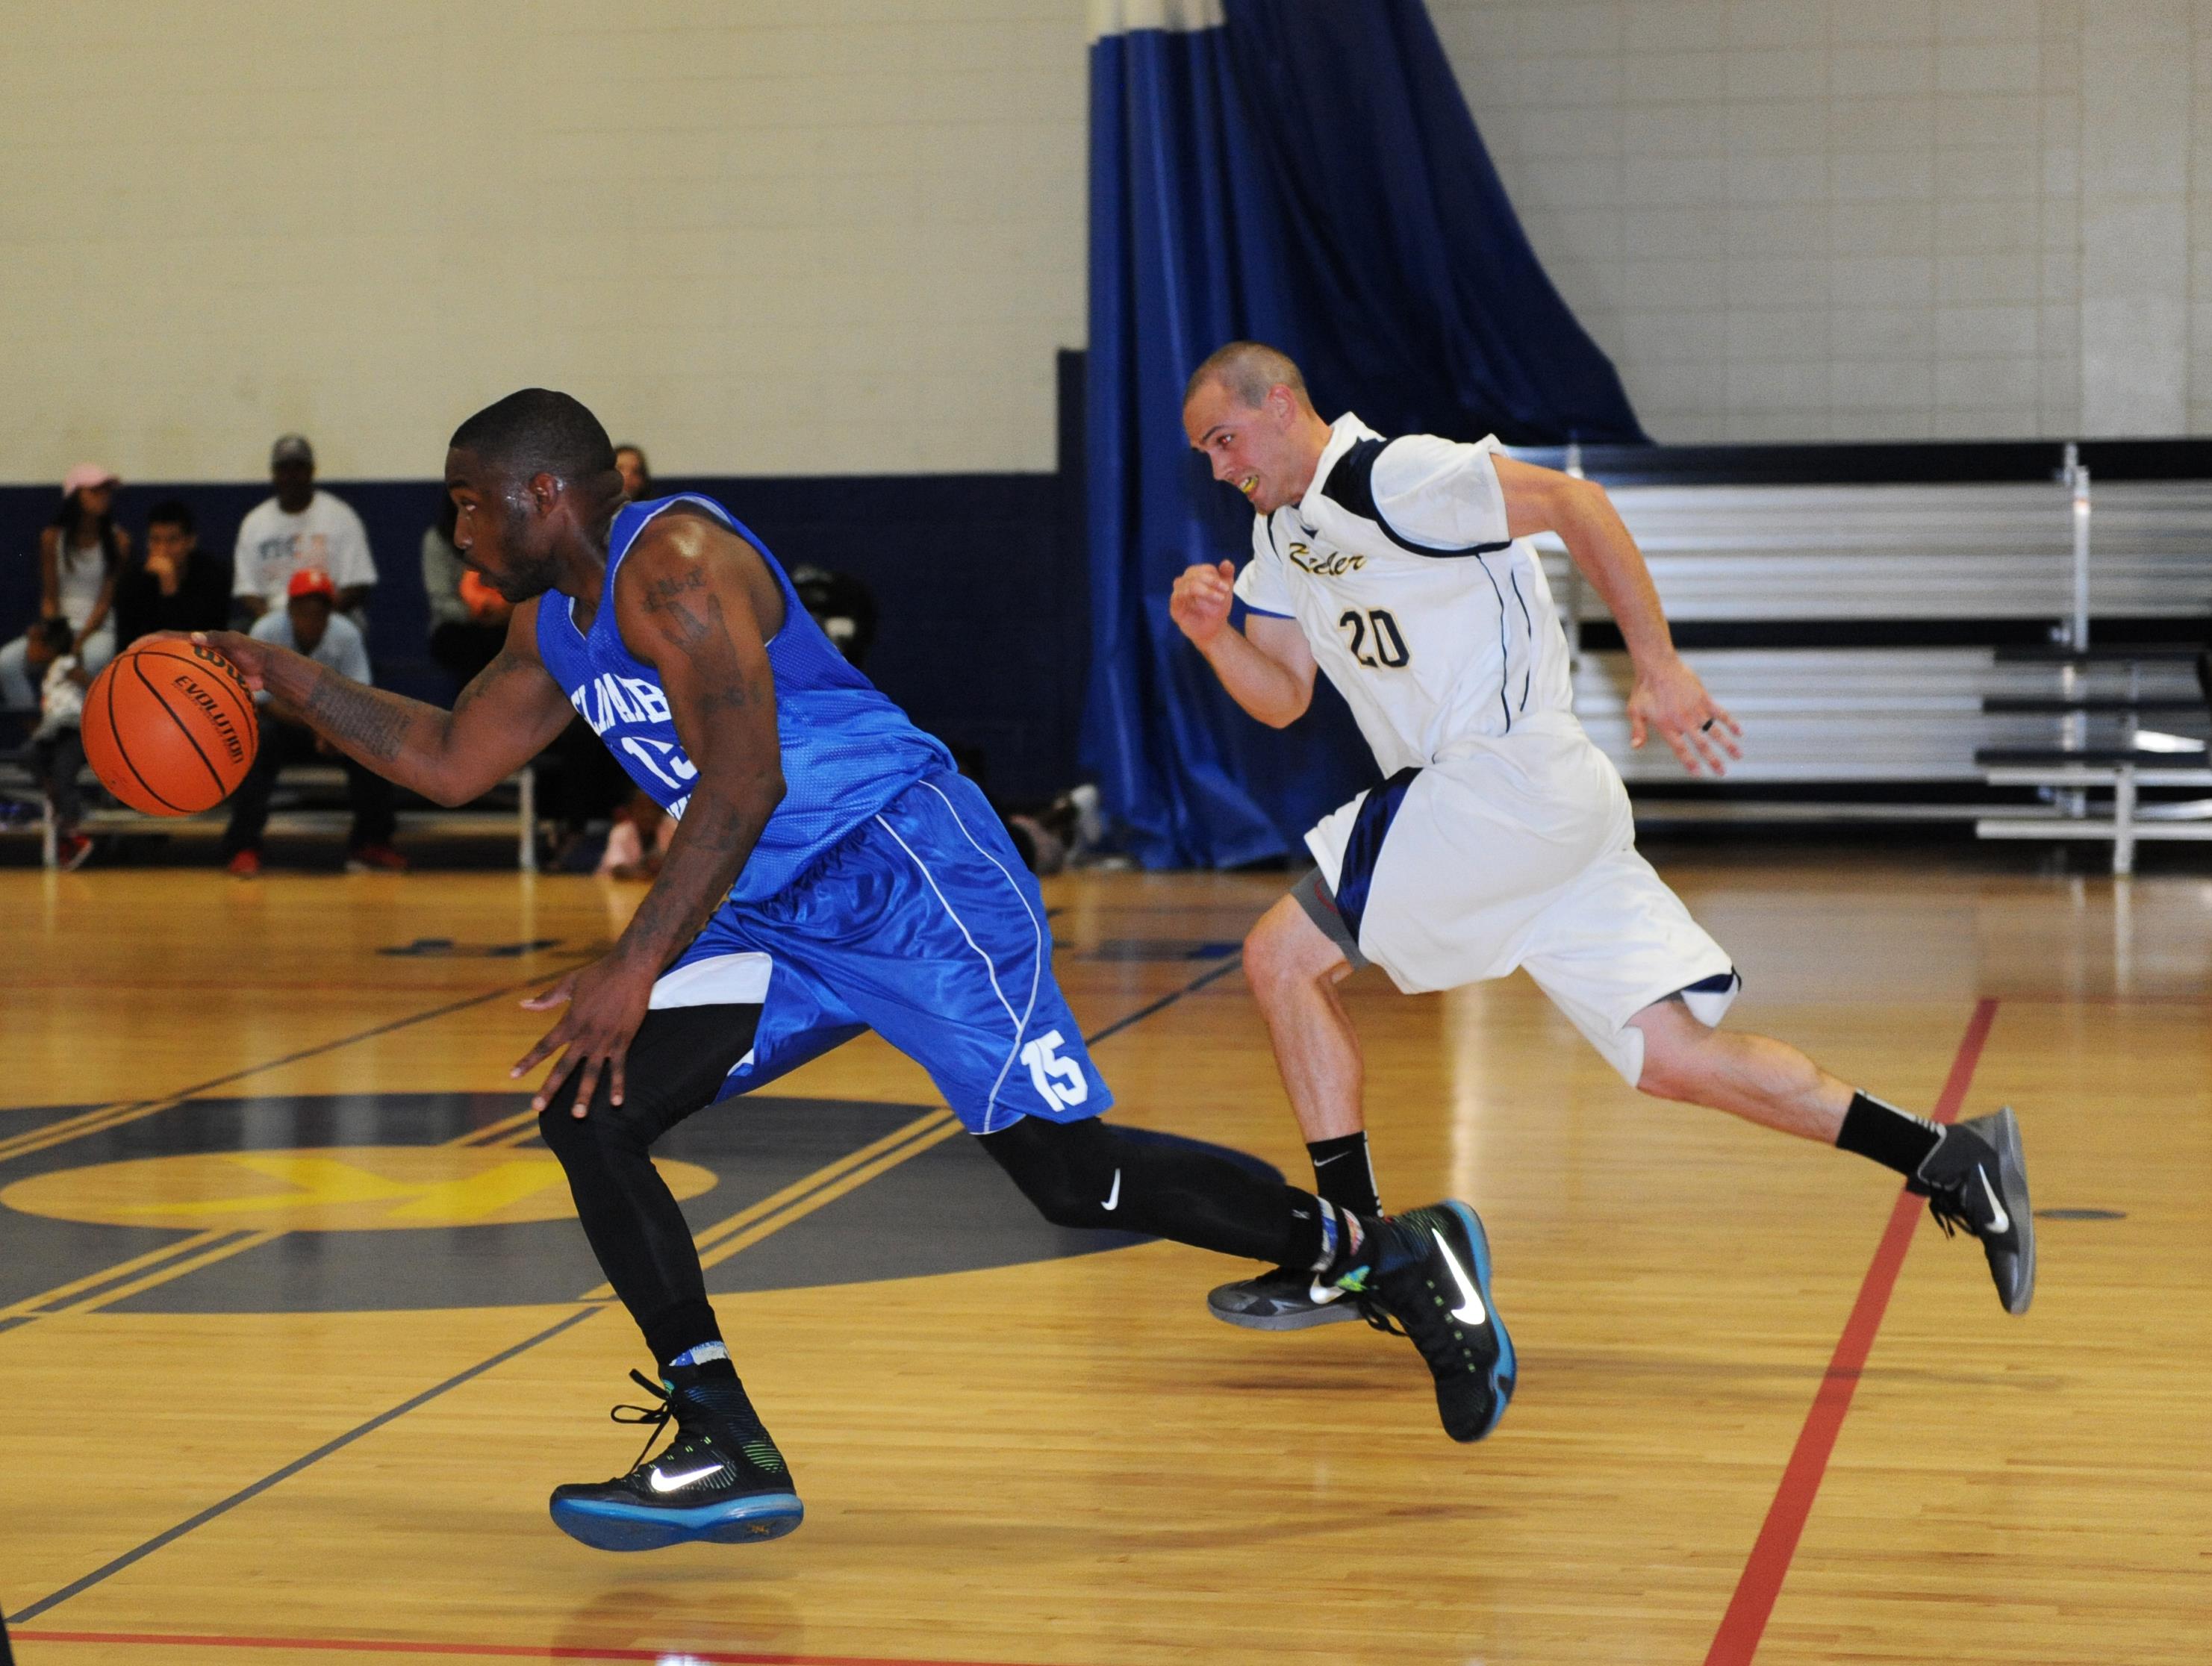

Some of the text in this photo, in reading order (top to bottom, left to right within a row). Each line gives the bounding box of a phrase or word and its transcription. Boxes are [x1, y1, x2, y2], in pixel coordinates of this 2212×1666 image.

[1339, 608, 1410, 669] 20
[174, 675, 244, 765] EVOLUTION
[1020, 1029, 1088, 1112] 15
